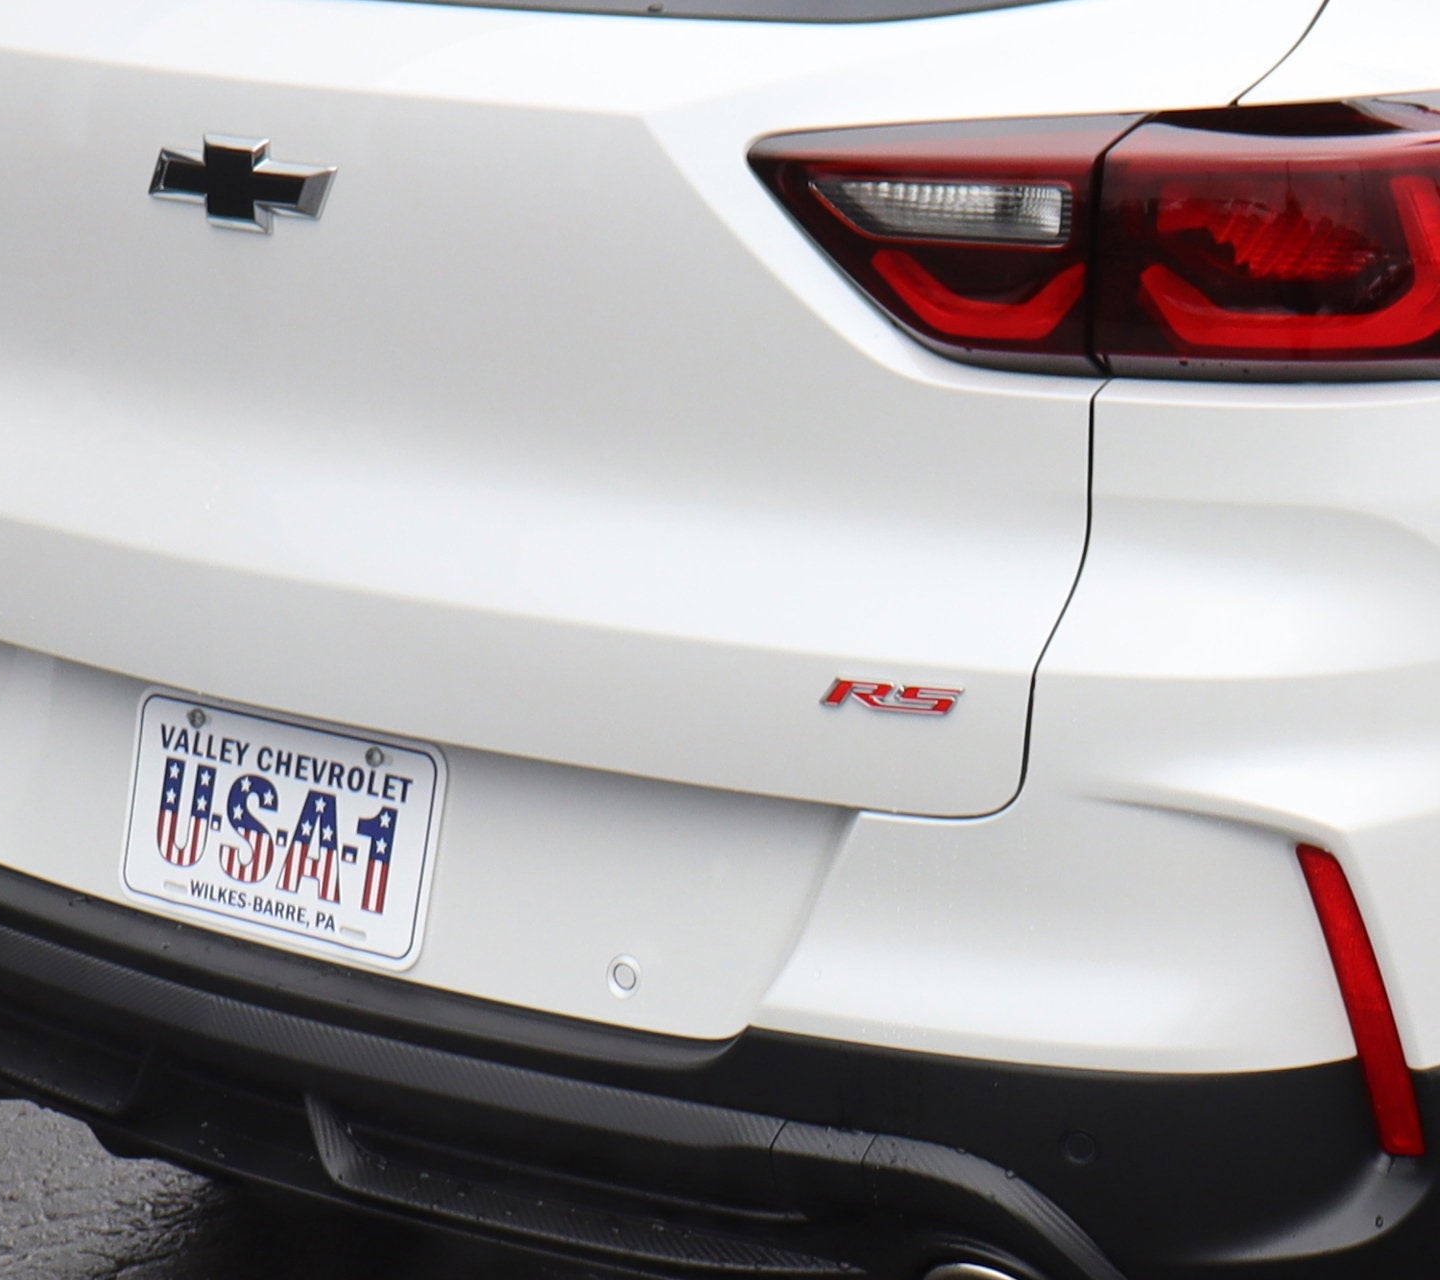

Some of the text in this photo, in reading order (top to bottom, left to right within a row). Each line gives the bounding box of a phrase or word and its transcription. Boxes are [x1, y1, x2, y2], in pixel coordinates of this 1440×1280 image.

[819, 677, 965, 716] RS
[161, 723, 414, 803] VALLEY CHEVROLET
[189, 879, 336, 933] WILKES-BARRE, PA
